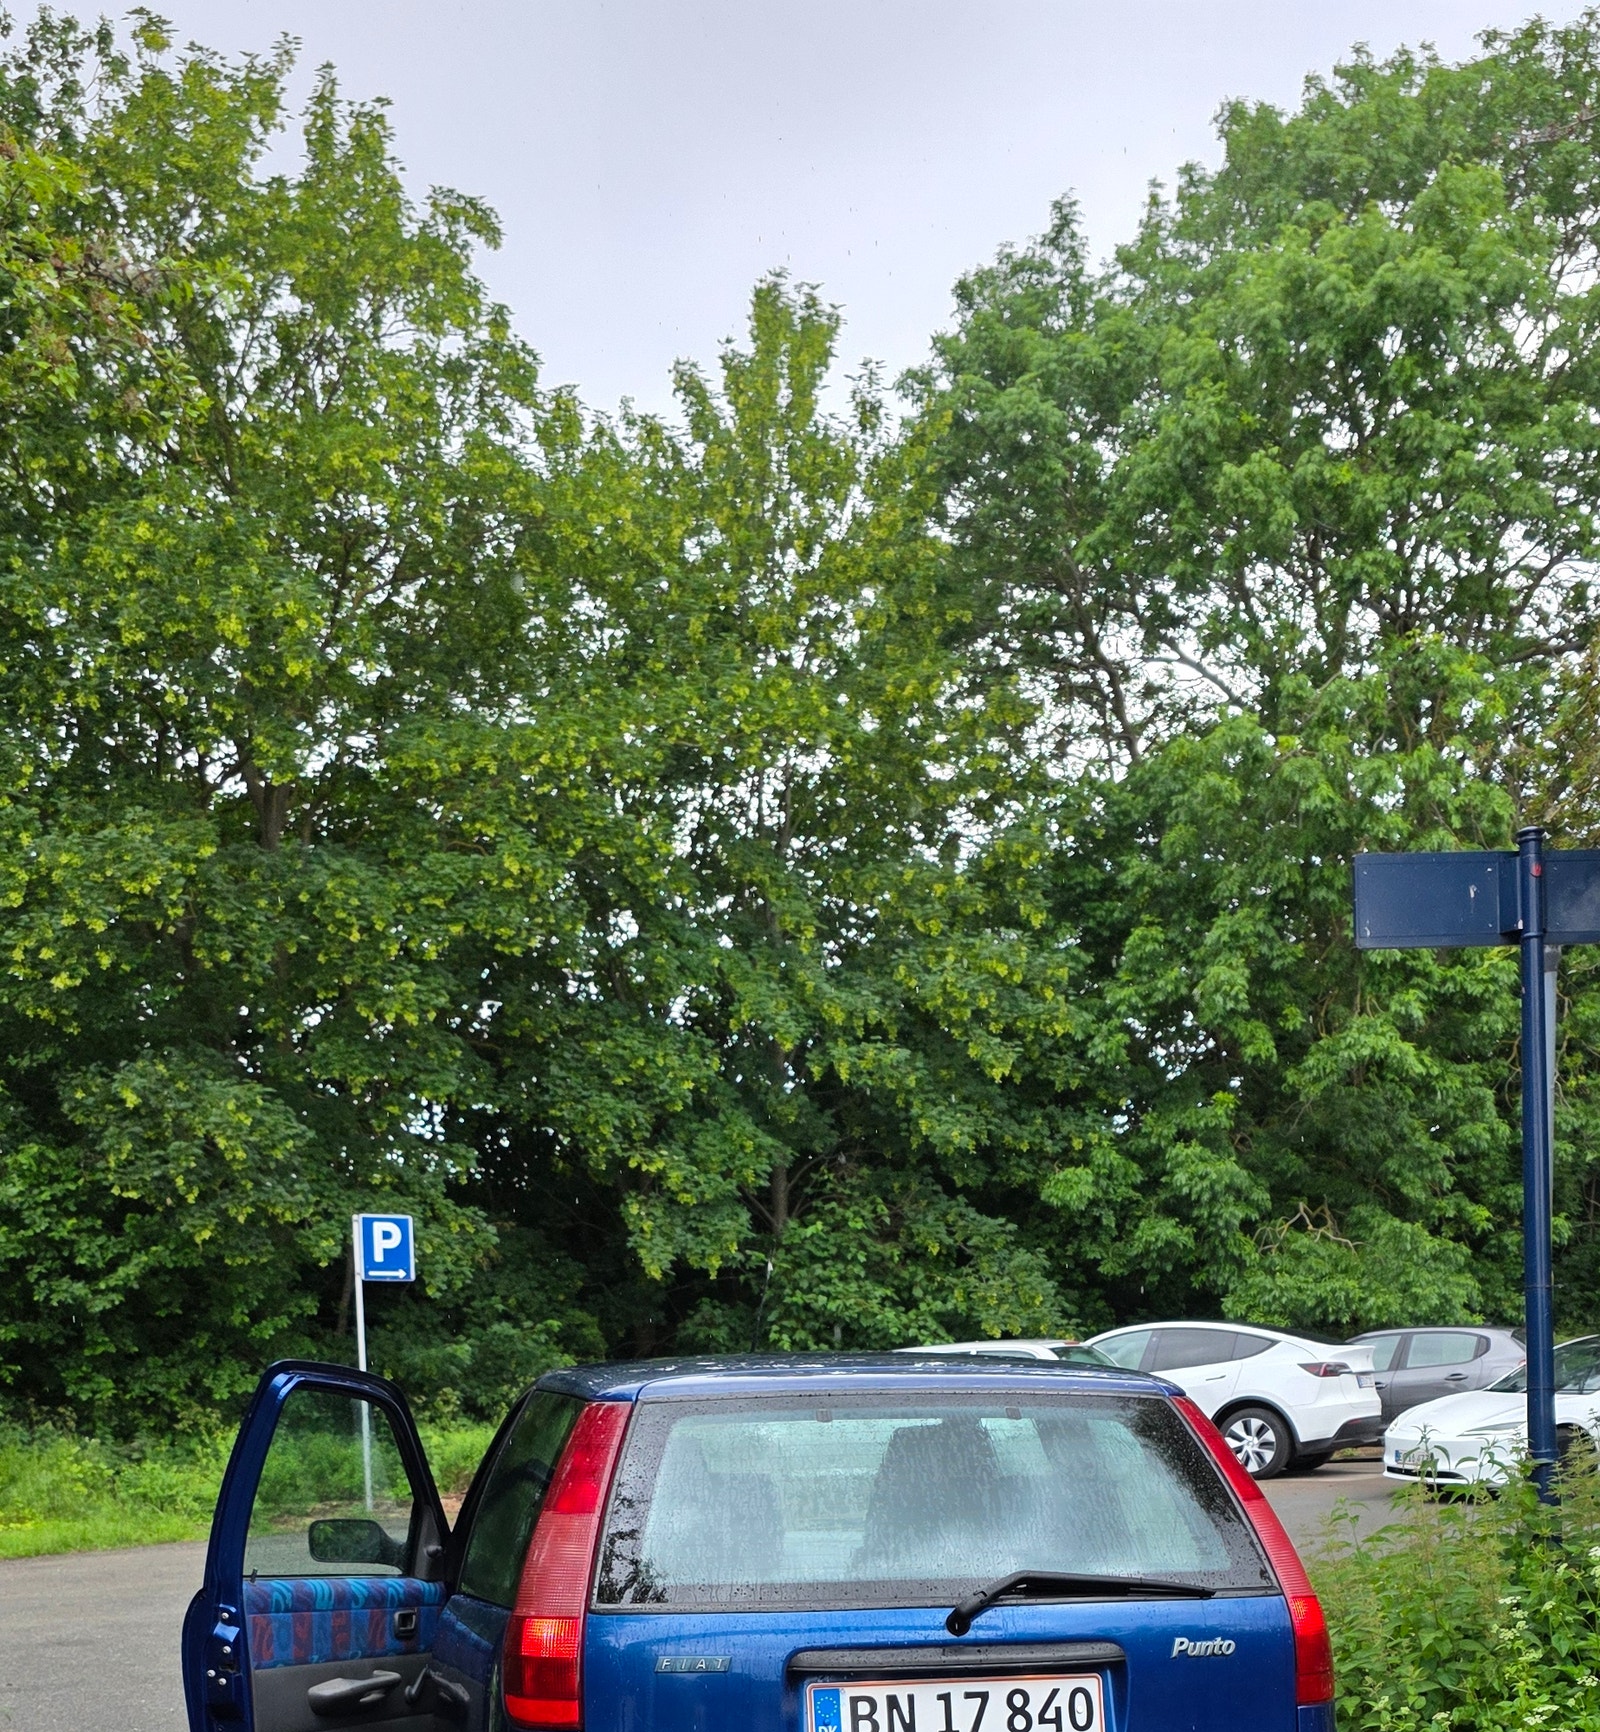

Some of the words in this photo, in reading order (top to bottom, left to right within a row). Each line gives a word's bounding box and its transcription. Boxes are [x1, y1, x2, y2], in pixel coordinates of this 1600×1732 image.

[372, 1221, 402, 1263] P
[1170, 1636, 1236, 1658] Punto
[661, 1658, 724, 1670] FIAT
